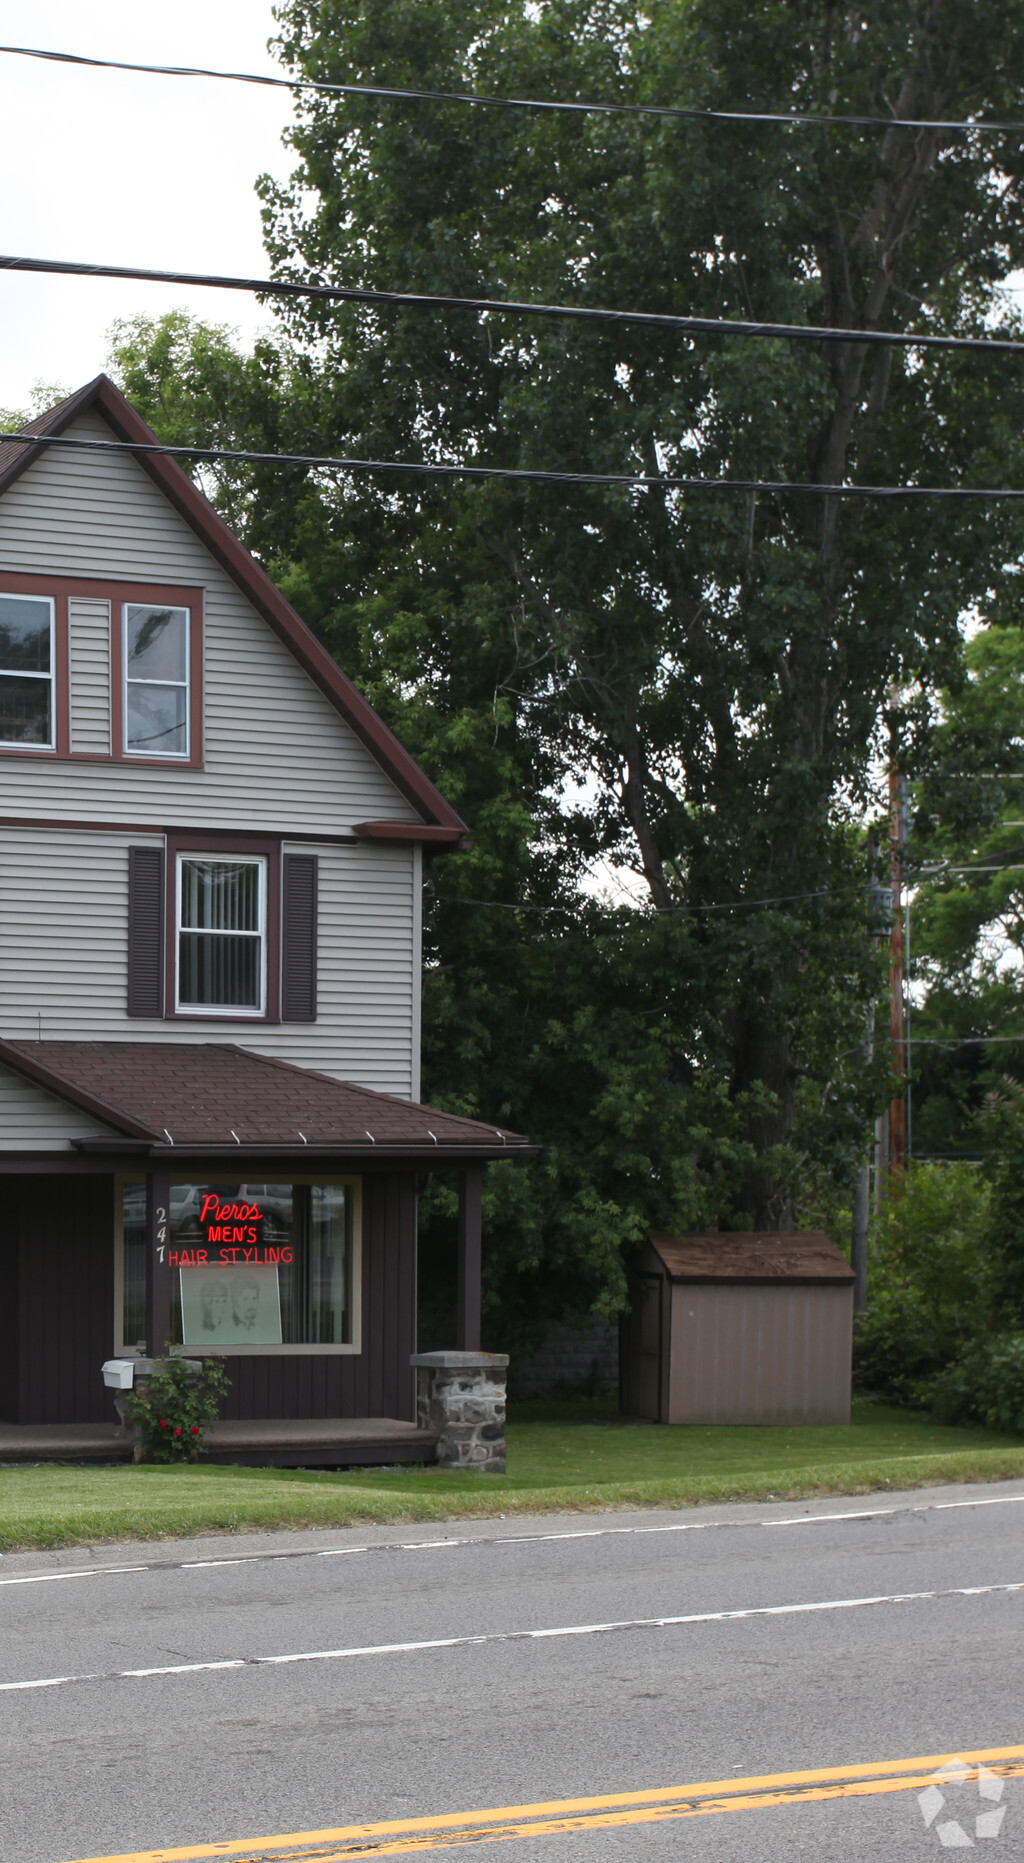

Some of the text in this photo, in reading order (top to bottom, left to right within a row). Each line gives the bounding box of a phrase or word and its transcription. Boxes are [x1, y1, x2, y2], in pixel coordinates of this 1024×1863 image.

[200, 1194, 264, 1222] Pieros
[208, 1225, 257, 1243] MEN'S
[168, 1246, 293, 1266] HAIR STYLING
